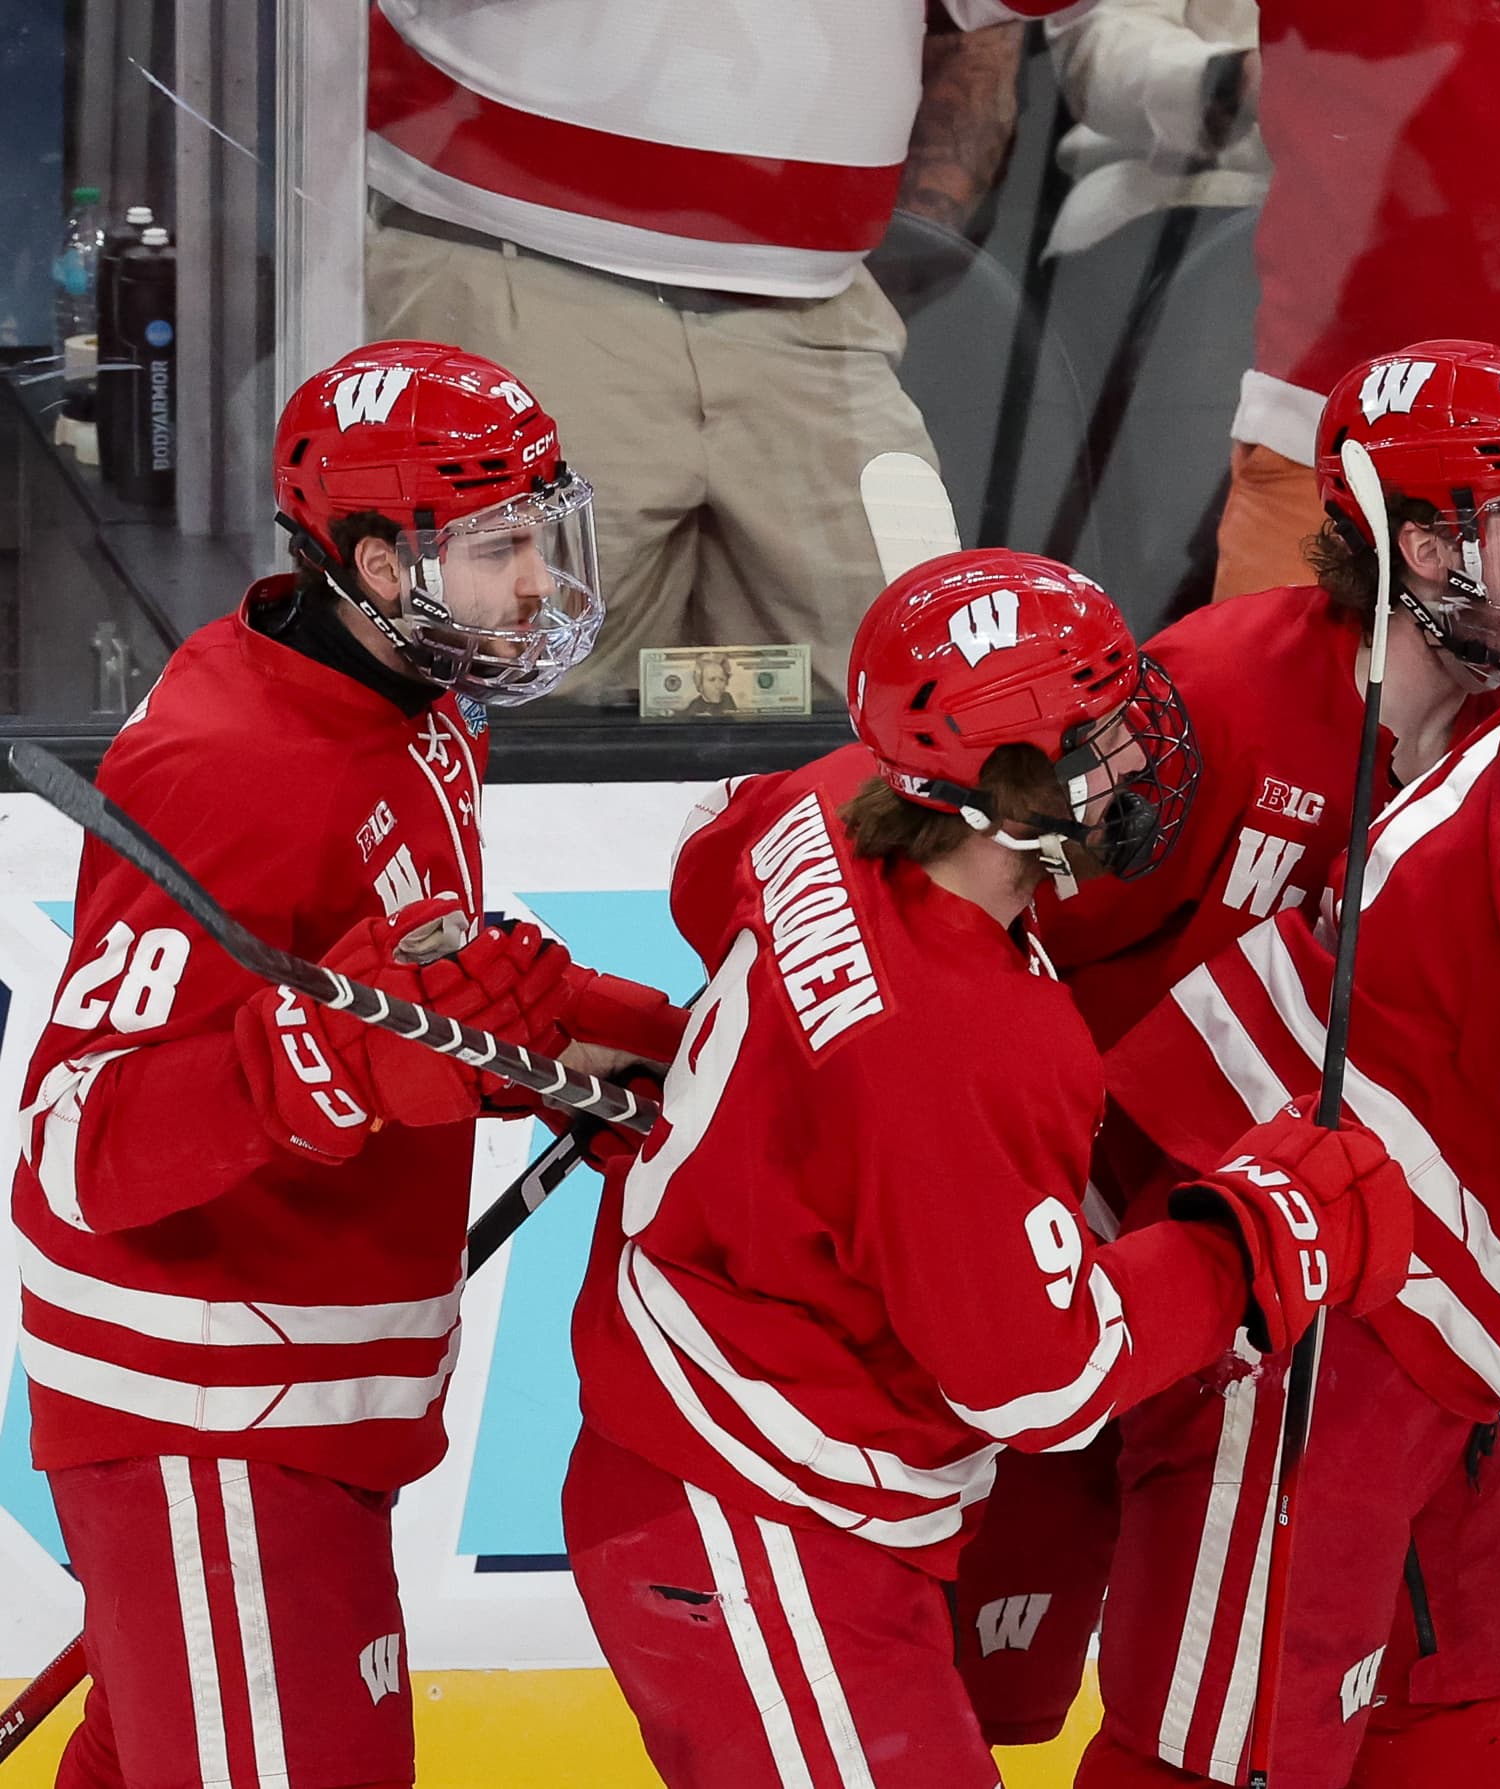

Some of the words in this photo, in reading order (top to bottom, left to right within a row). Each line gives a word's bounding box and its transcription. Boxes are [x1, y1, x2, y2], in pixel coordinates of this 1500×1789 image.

[150, 360, 169, 471] BODYARMOR
[334, 369, 413, 433] W
[1359, 361, 1437, 427] W
[522, 430, 555, 463] CCM
[360, 600, 407, 648] CCM
[412, 597, 449, 620] CCM
[949, 588, 1019, 668] W
[1399, 592, 1445, 638] CCM
[750, 793, 883, 1052] KUKKONEN
[52, 920, 191, 1034] 28
[1024, 1196, 1082, 1310] 9
[1216, 1155, 1329, 1301] CCM
[976, 1592, 1053, 1659] W
[358, 1632, 401, 1706] W
[1339, 1644, 1388, 1724] W
